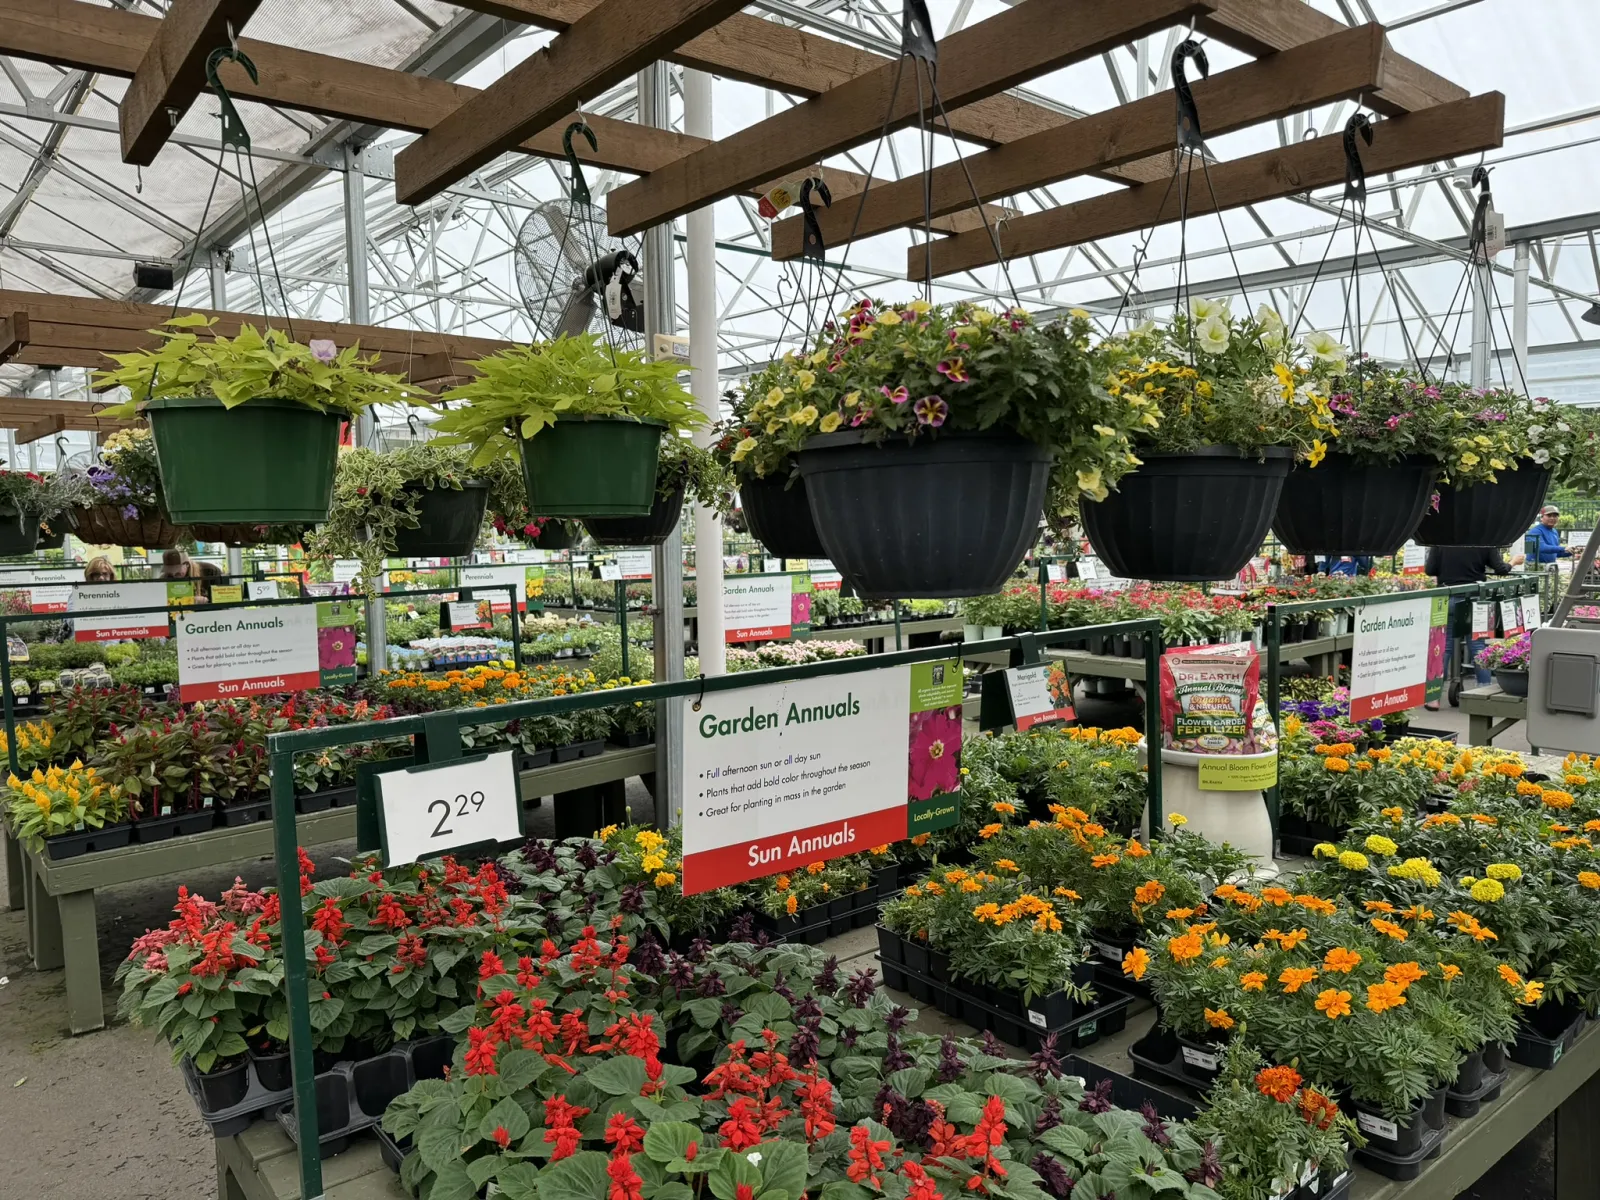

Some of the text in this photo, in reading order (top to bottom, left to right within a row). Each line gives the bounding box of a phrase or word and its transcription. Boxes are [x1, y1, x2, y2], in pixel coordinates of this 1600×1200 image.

[749, 584, 774, 593] Annuals
[78, 590, 120, 600] Perennials
[185, 617, 284, 634] Garden Annuals
[1360, 616, 1386, 633] Garden
[1388, 612, 1414, 629] Annuals
[112, 628, 149, 636] Perennials
[749, 628, 772, 637] Annuals
[1017, 672, 1037, 680] Marigold
[1200, 672, 1240, 681] EARTH
[218, 676, 285, 694] Sun Annuals
[1178, 683, 1242, 694] Annual Bloom
[1191, 695, 1230, 705] Organic
[1370, 690, 1408, 710] Sun Annuals
[699, 692, 860, 738] Garden Annuals
[1043, 712, 1057, 721] Annual
[1213, 718, 1246, 726] GARDEN
[1177, 725, 1246, 735] FERTILIZER
[706, 768, 720, 779] Full
[722, 764, 758, 777] afternoon
[784, 755, 792, 765] all
[794, 754, 807, 764] day
[809, 752, 821, 761] sun
[706, 760, 871, 798] Plants that add bold color throughout the season
[706, 781, 846, 817] Great for planting in mass in the garden
[914, 806, 955, 822] Locally-Grown
[748, 822, 856, 867] Sun Annuals
